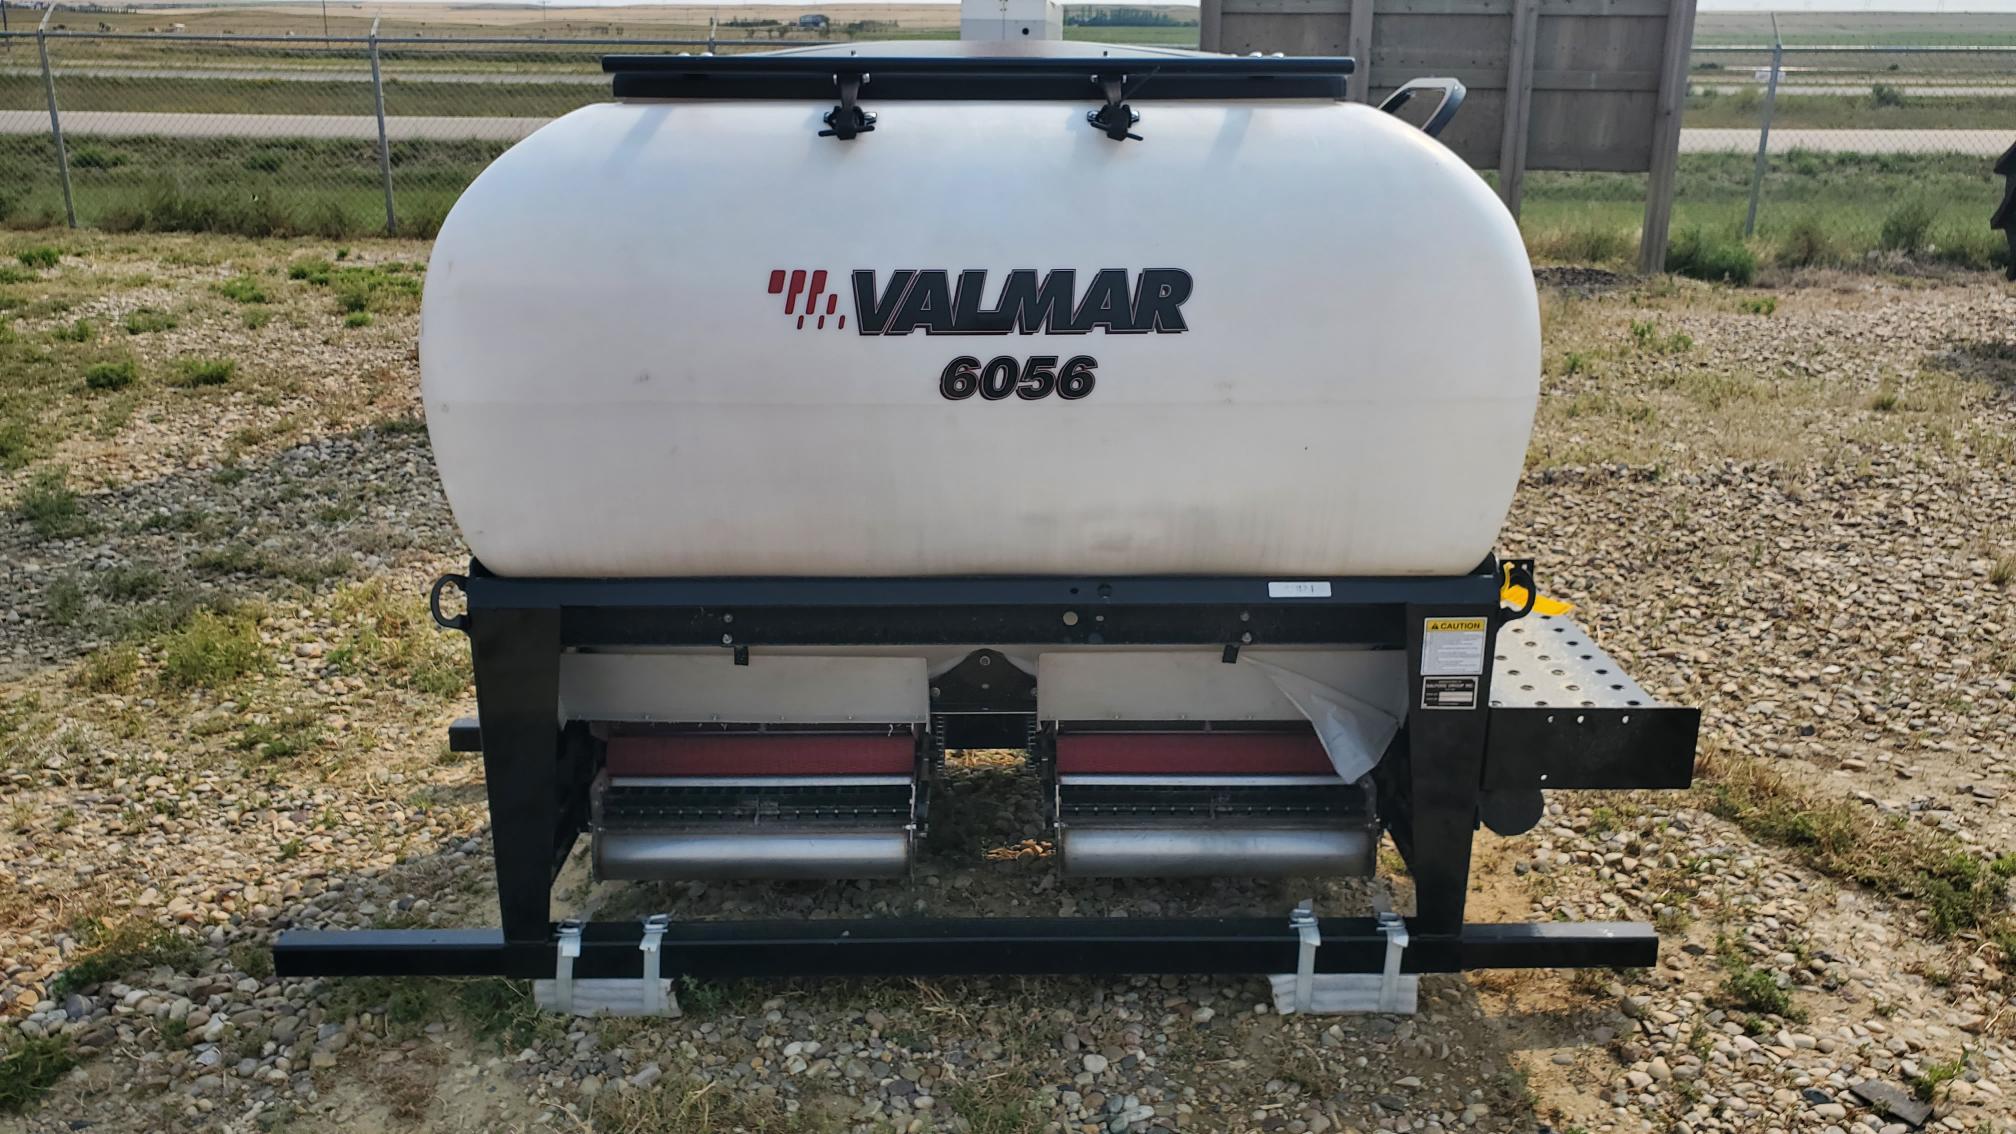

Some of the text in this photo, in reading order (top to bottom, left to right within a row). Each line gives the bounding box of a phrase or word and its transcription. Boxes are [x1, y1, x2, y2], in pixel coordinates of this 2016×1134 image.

[851, 268, 1194, 336] VALMAR
[939, 355, 1098, 401] 6056
[1440, 622, 1480, 630] CAUTION
